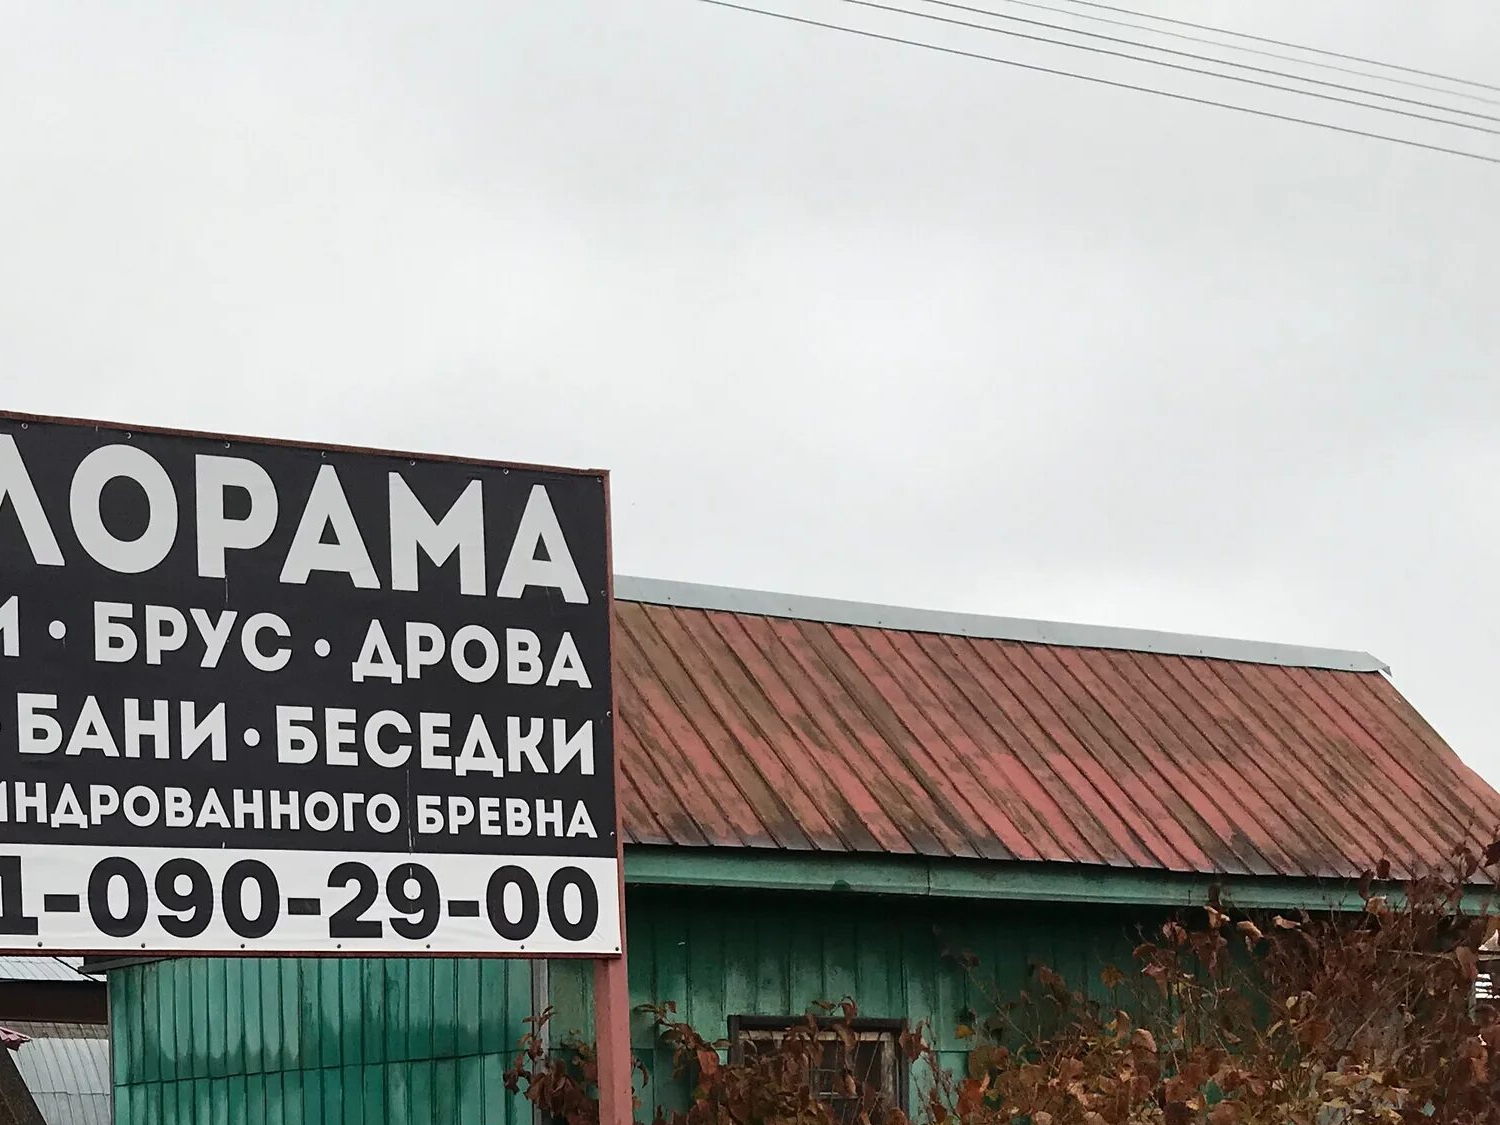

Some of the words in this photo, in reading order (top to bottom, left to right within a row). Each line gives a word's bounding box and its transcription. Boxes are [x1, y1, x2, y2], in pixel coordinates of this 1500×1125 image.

[94, 601, 291, 671] БРУС
[352, 619, 591, 688] ДРОВА
[18, 693, 226, 760] БАНИ
[276, 706, 594, 777] БЕСЕДКИ
[417, 795, 597, 838] БРЕВНА
